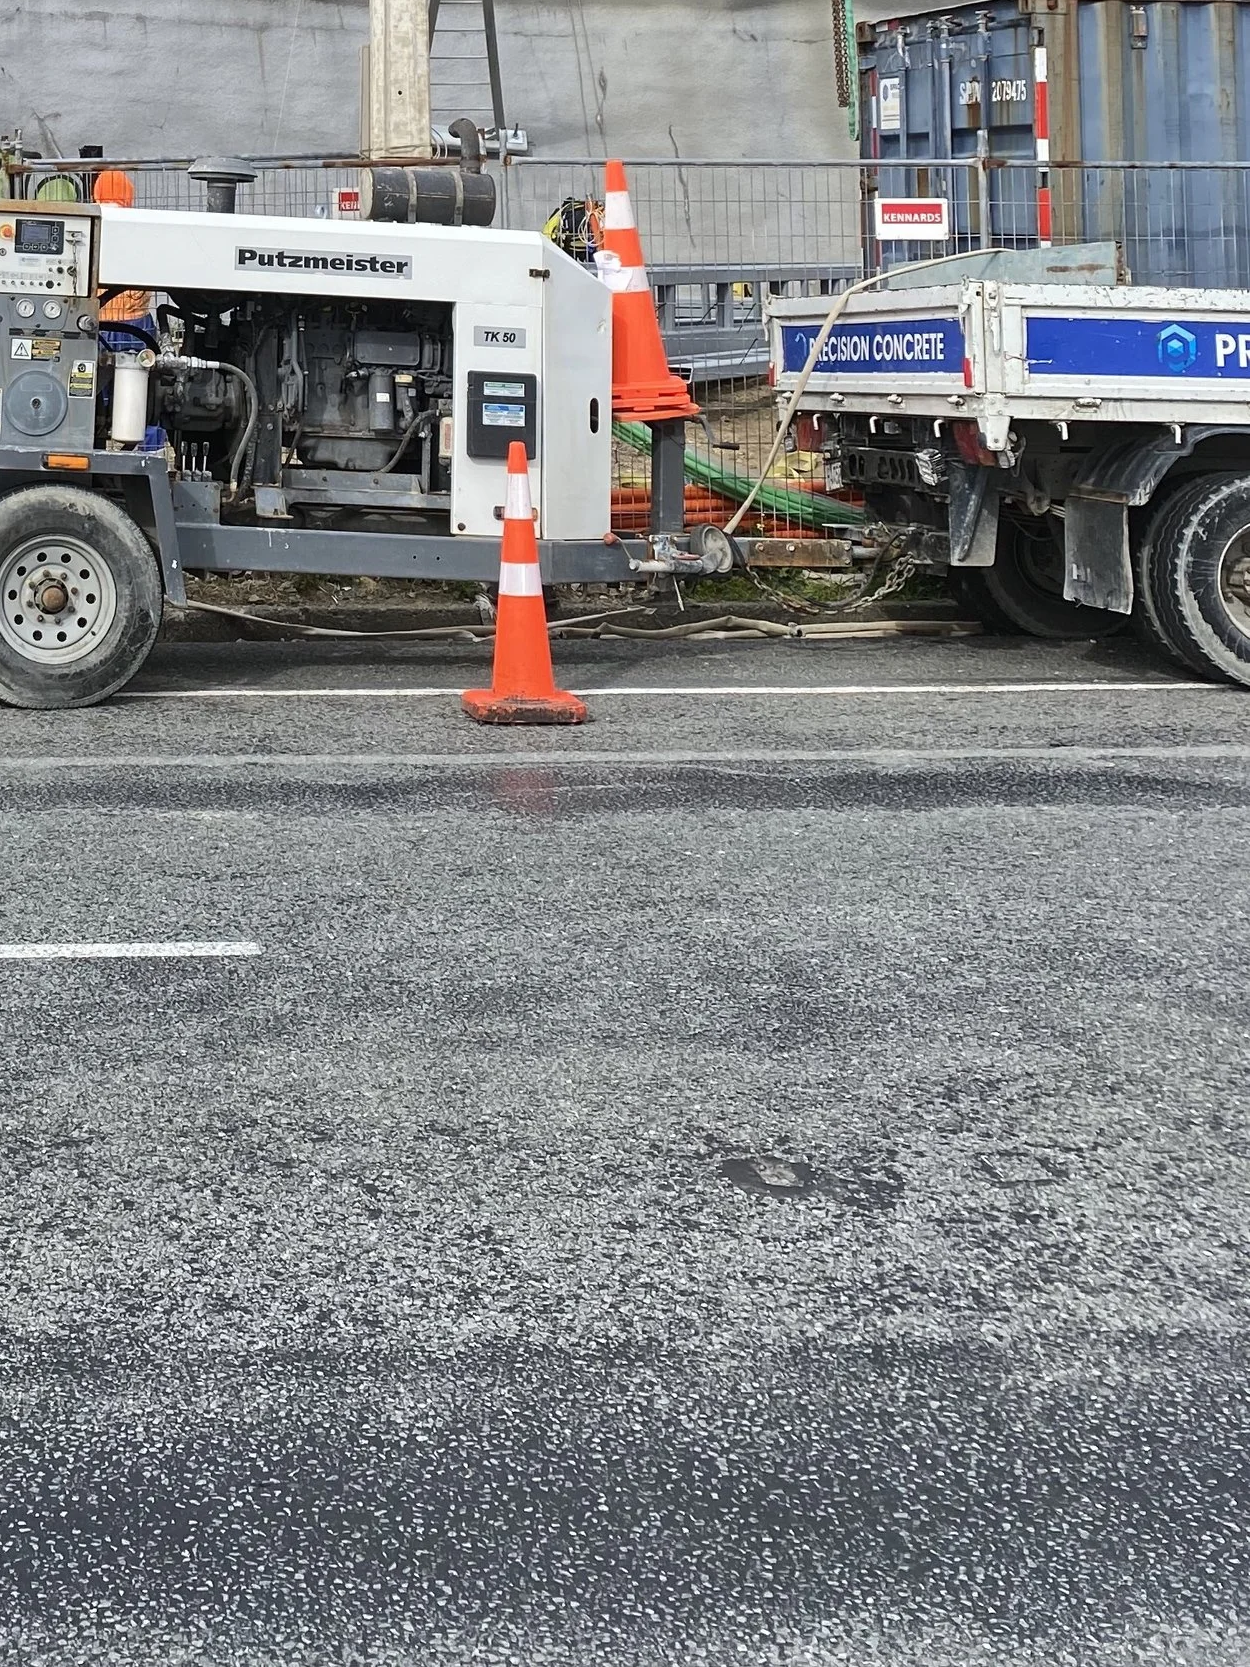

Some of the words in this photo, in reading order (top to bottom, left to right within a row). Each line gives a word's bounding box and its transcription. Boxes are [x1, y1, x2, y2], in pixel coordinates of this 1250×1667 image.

[991, 79, 1027, 102] 2079475
[883, 213, 942, 223] KENNARDS
[238, 248, 408, 274] Putzmeister
[484, 331, 500, 343] TK
[502, 332, 516, 343] 50
[872, 332, 945, 361] CONCRETE
